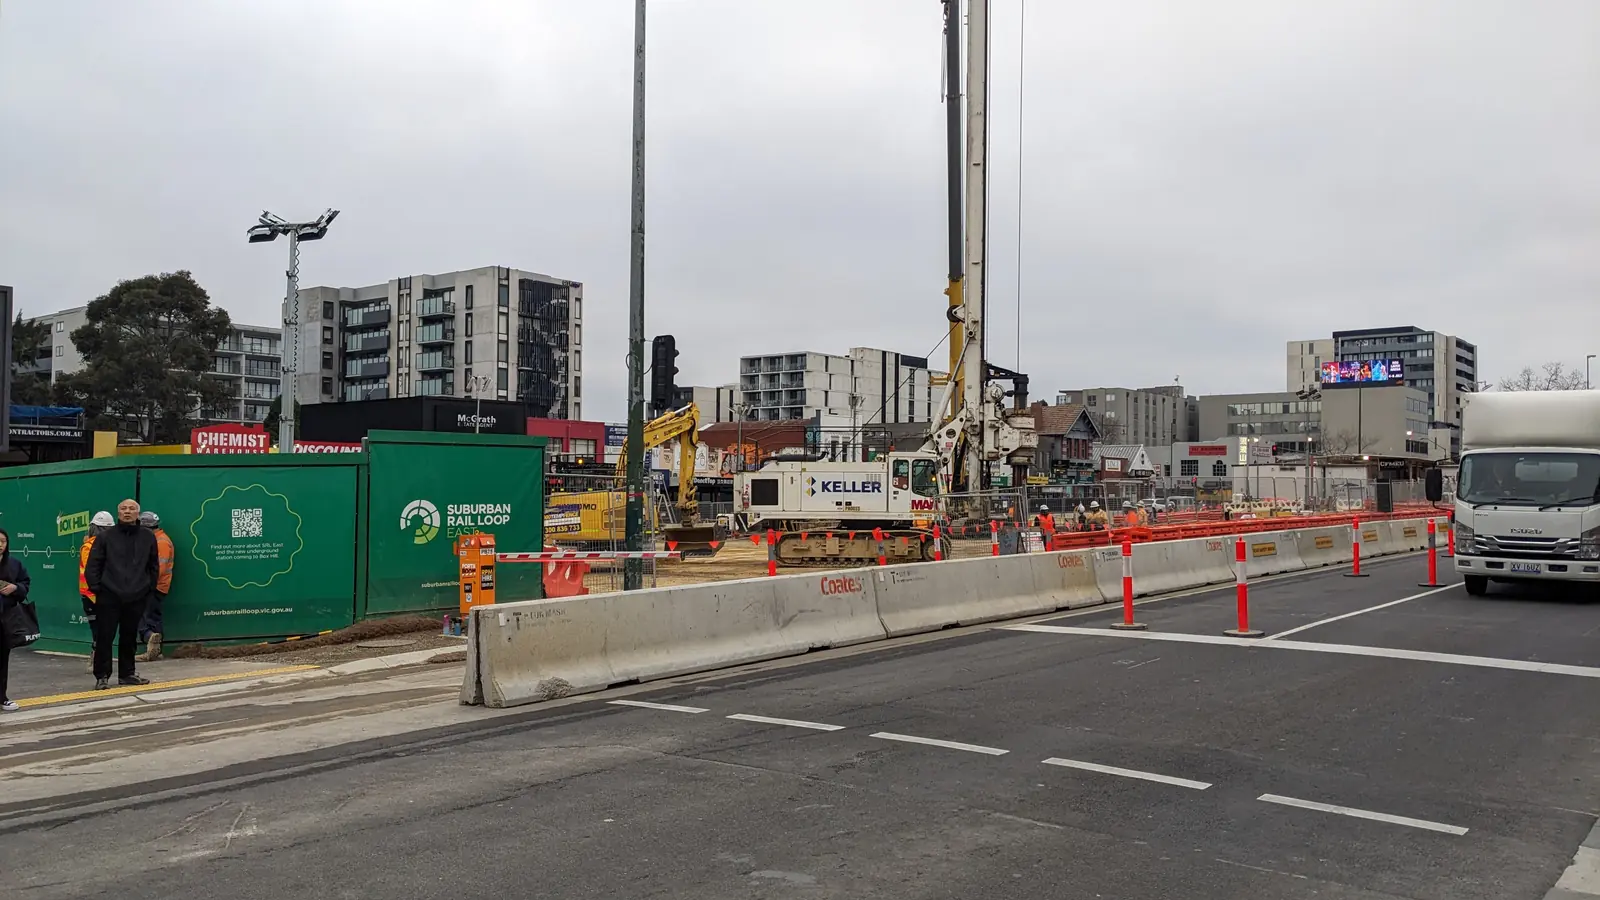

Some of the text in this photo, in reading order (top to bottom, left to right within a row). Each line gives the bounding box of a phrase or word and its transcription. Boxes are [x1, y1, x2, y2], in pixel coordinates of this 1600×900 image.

[457, 414, 497, 424] McGrath
[197, 431, 267, 448] CHEMIST
[821, 481, 882, 493] KELLER
[447, 503, 511, 515] SUBURBAN
[73, 515, 87, 529] HILL
[447, 514, 510, 527] RAIL LOOP
[447, 526, 478, 539] EAST
[820, 576, 862, 595] Coates
[203, 607, 293, 616] suburbanrailloop.vic.gov.au
